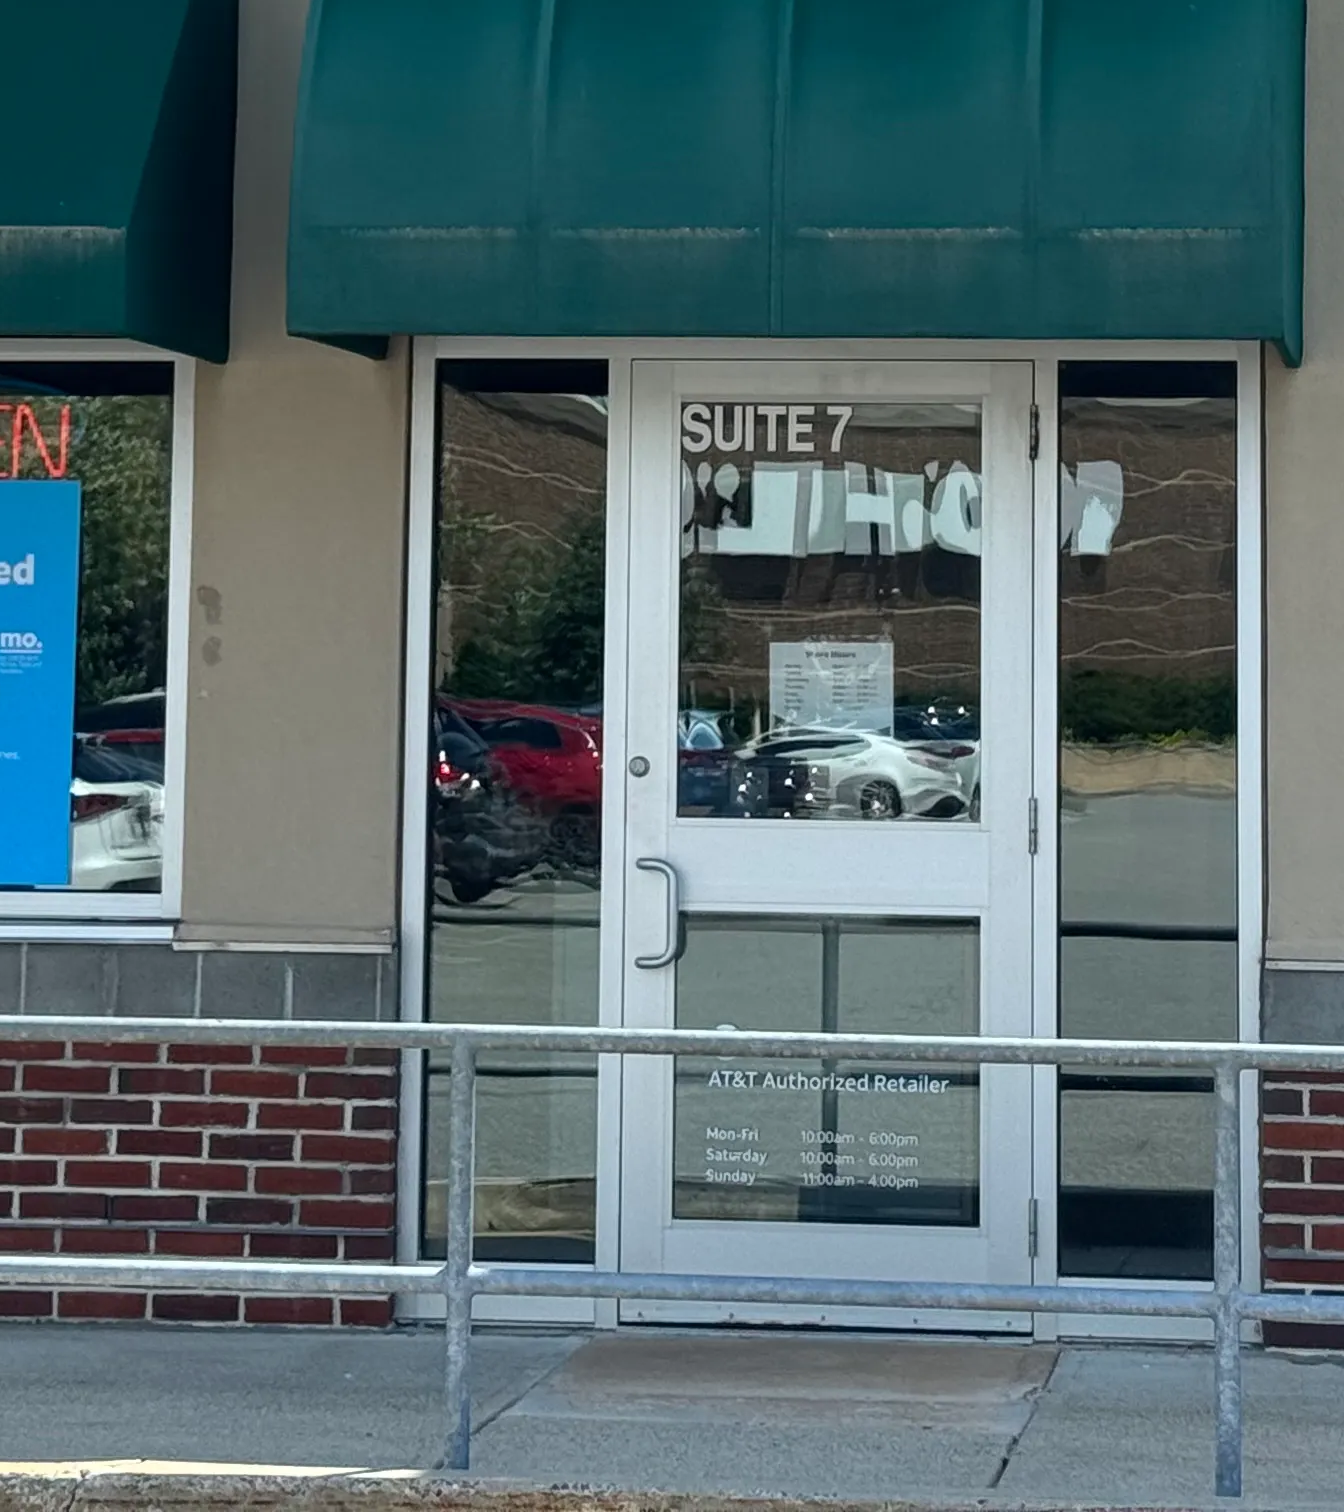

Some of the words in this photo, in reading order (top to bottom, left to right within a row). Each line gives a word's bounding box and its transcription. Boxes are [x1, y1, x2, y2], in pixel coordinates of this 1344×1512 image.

[681, 403, 815, 454] SUITE
[827, 405, 854, 453] 7
[0, 632, 44, 649] mo.
[708, 1069, 758, 1089] AT&T
[763, 1071, 869, 1092] Authorized
[873, 1073, 950, 1094] Retailer
[706, 1127, 759, 1142] Mon-Fri
[801, 1130, 855, 1144] 10:00am
[869, 1132, 919, 1148] 6:00pm
[705, 1148, 767, 1166] Saturday
[800, 1151, 855, 1166] 10:00am
[705, 1169, 757, 1186] Sunday
[802, 1172, 856, 1187] 11:00am
[868, 1174, 919, 1191] 4:00pm
